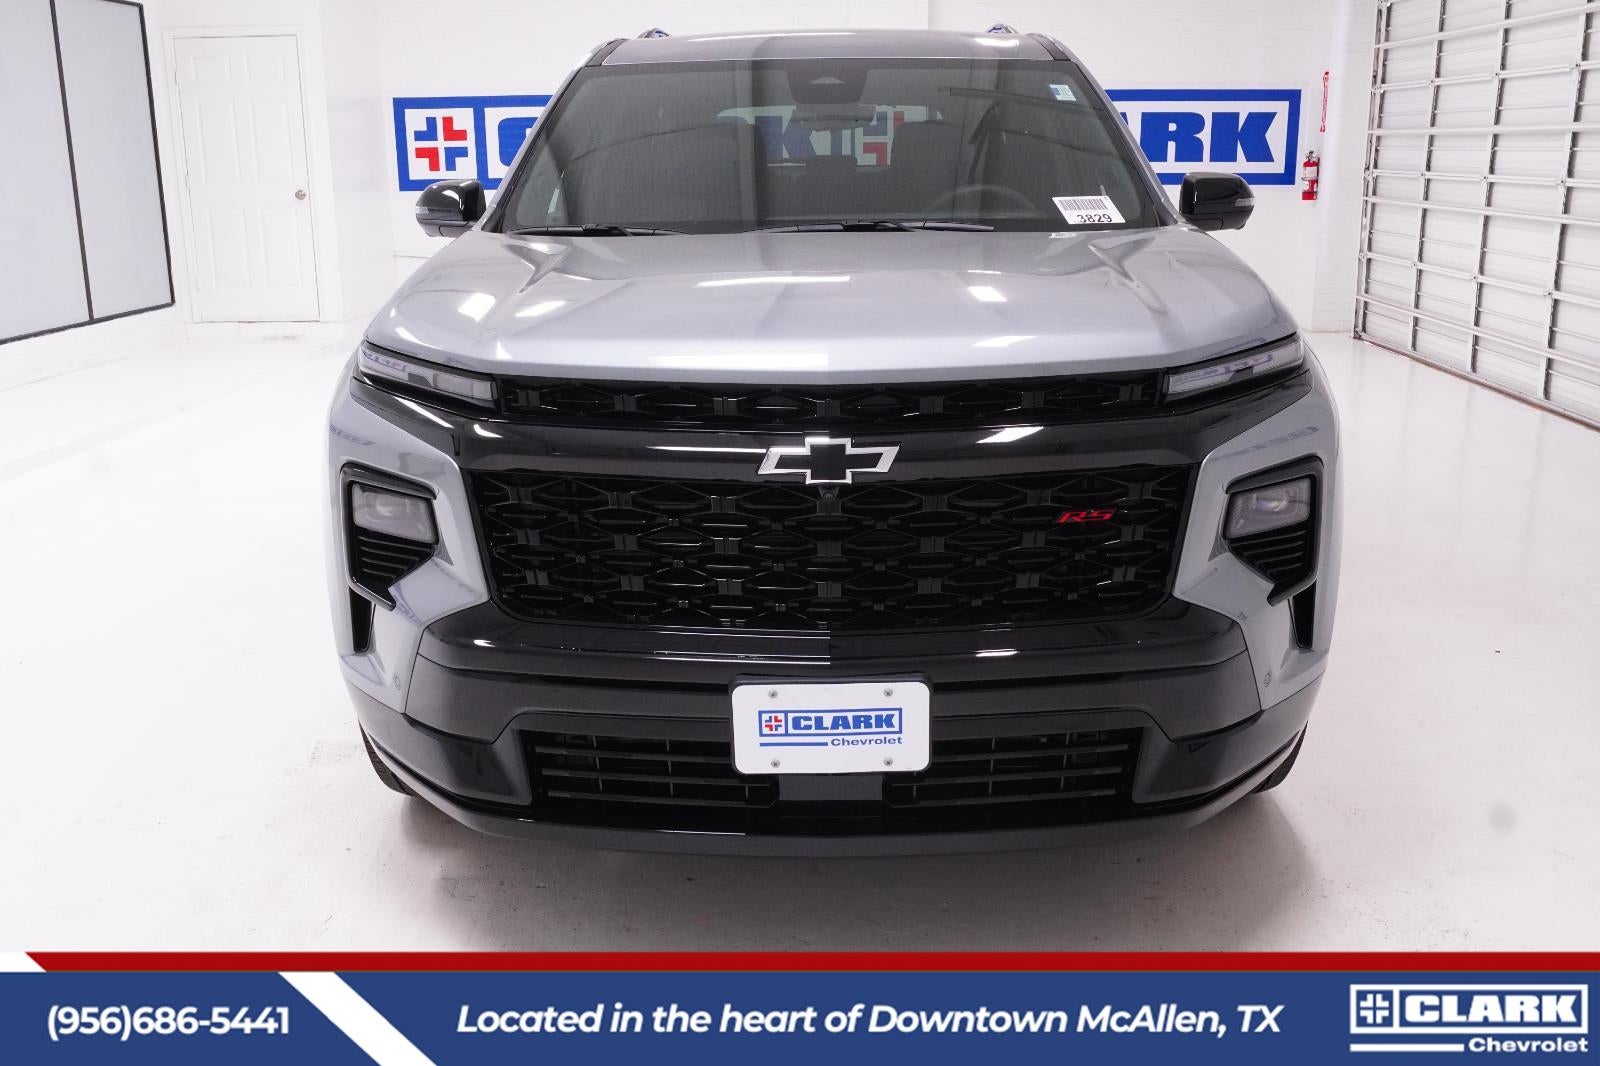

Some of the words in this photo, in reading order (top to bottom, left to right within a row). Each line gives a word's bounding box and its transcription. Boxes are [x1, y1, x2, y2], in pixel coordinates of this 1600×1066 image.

[1076, 213, 1113, 223] 3829
[1057, 509, 1114, 523] RS
[791, 713, 896, 731] CLARK
[830, 736, 903, 747] Chevrolet
